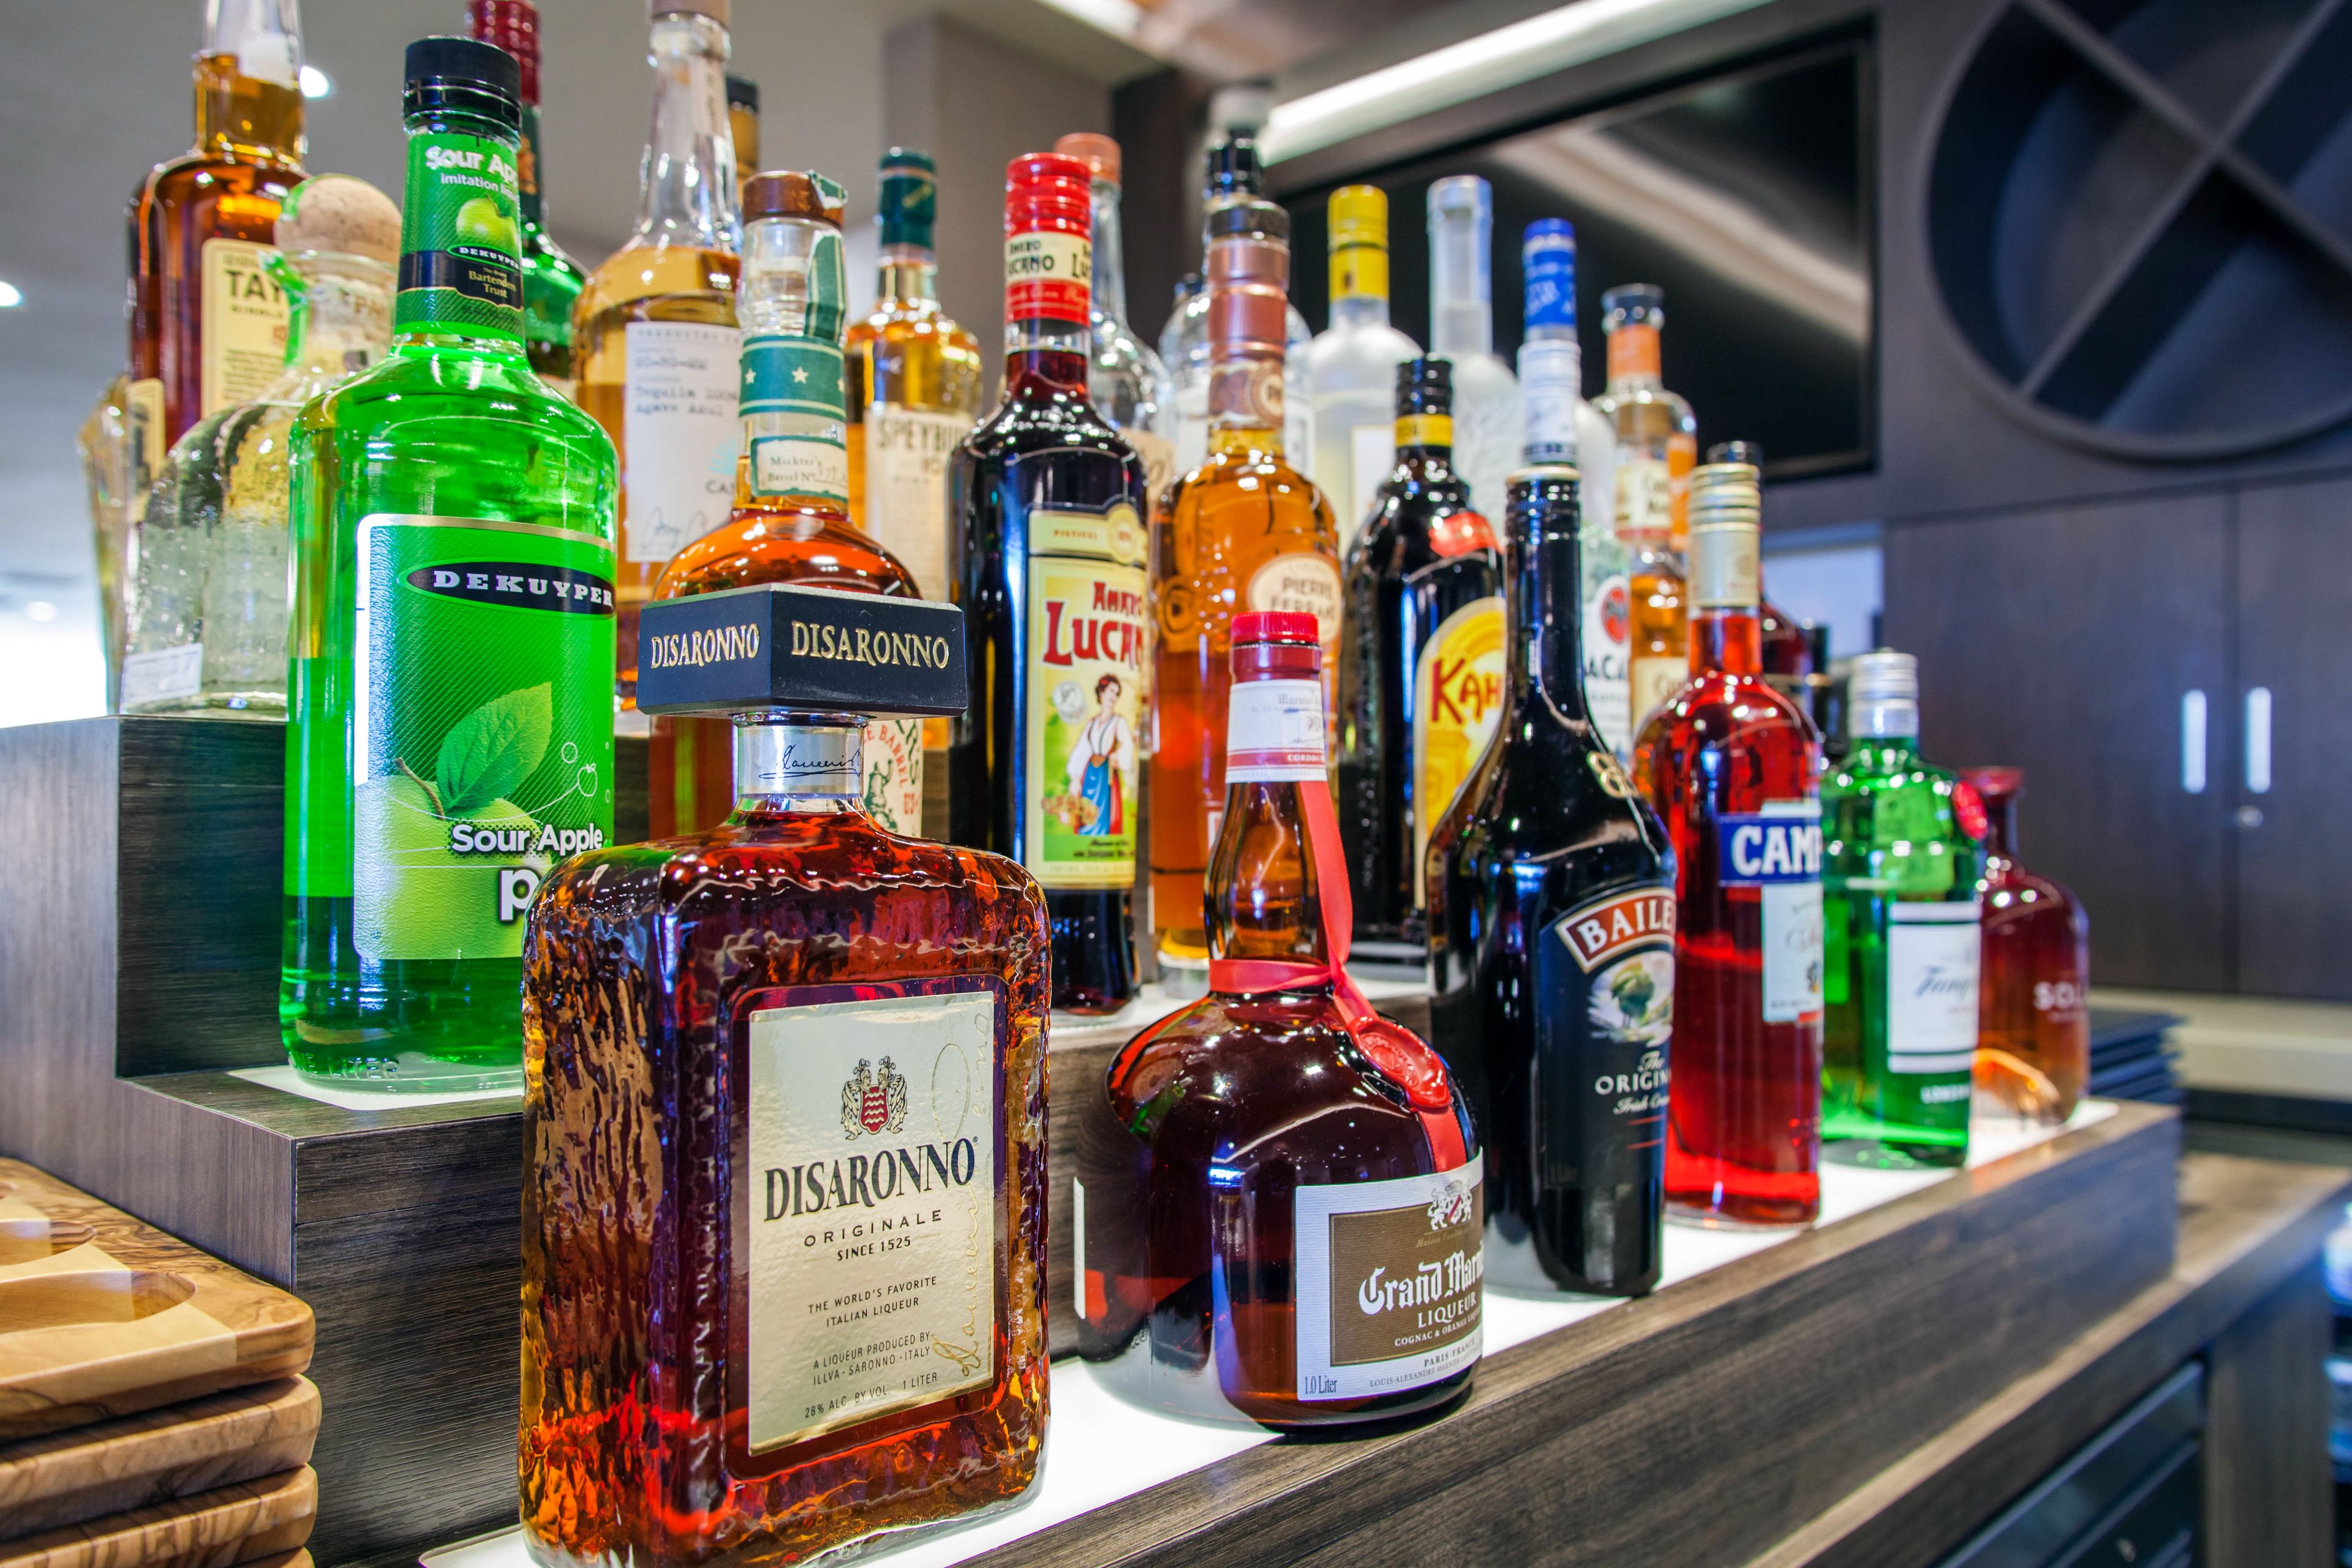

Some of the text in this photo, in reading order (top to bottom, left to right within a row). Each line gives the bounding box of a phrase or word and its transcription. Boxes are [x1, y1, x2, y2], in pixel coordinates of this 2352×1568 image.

[425, 146, 483, 170] Sour
[440, 172, 499, 192] imitation
[483, 283, 508, 298] Trust
[433, 570, 613, 607] DEKUYPER
[651, 624, 760, 669] DISARONNO
[791, 620, 950, 669] DISARONNO
[451, 823, 603, 856] Sour Apple
[1637, 1050, 1665, 1073] The
[804, 1210, 943, 1248] ORIGINALE
[837, 1235, 912, 1262] SINCE 1525
[808, 1276, 938, 1314] THE WORLD'S FAVORITE
[1358, 1261, 1442, 1316] Grand
[826, 1297, 919, 1328] ITALIAN LIQUEUR
[1417, 1291, 1477, 1329] LIQUEUR
[813, 1330, 931, 1370] A LIQUEUR PRODUCED BY
[1394, 1331, 1433, 1347] COGNAC
[805, 1403, 825, 1419] 28%
[854, 1392, 867, 1404] BY
[902, 1379, 907, 1390] 1
[911, 1371, 938, 1389] LITER
[1304, 1374, 1338, 1394] 1.0 Liter
